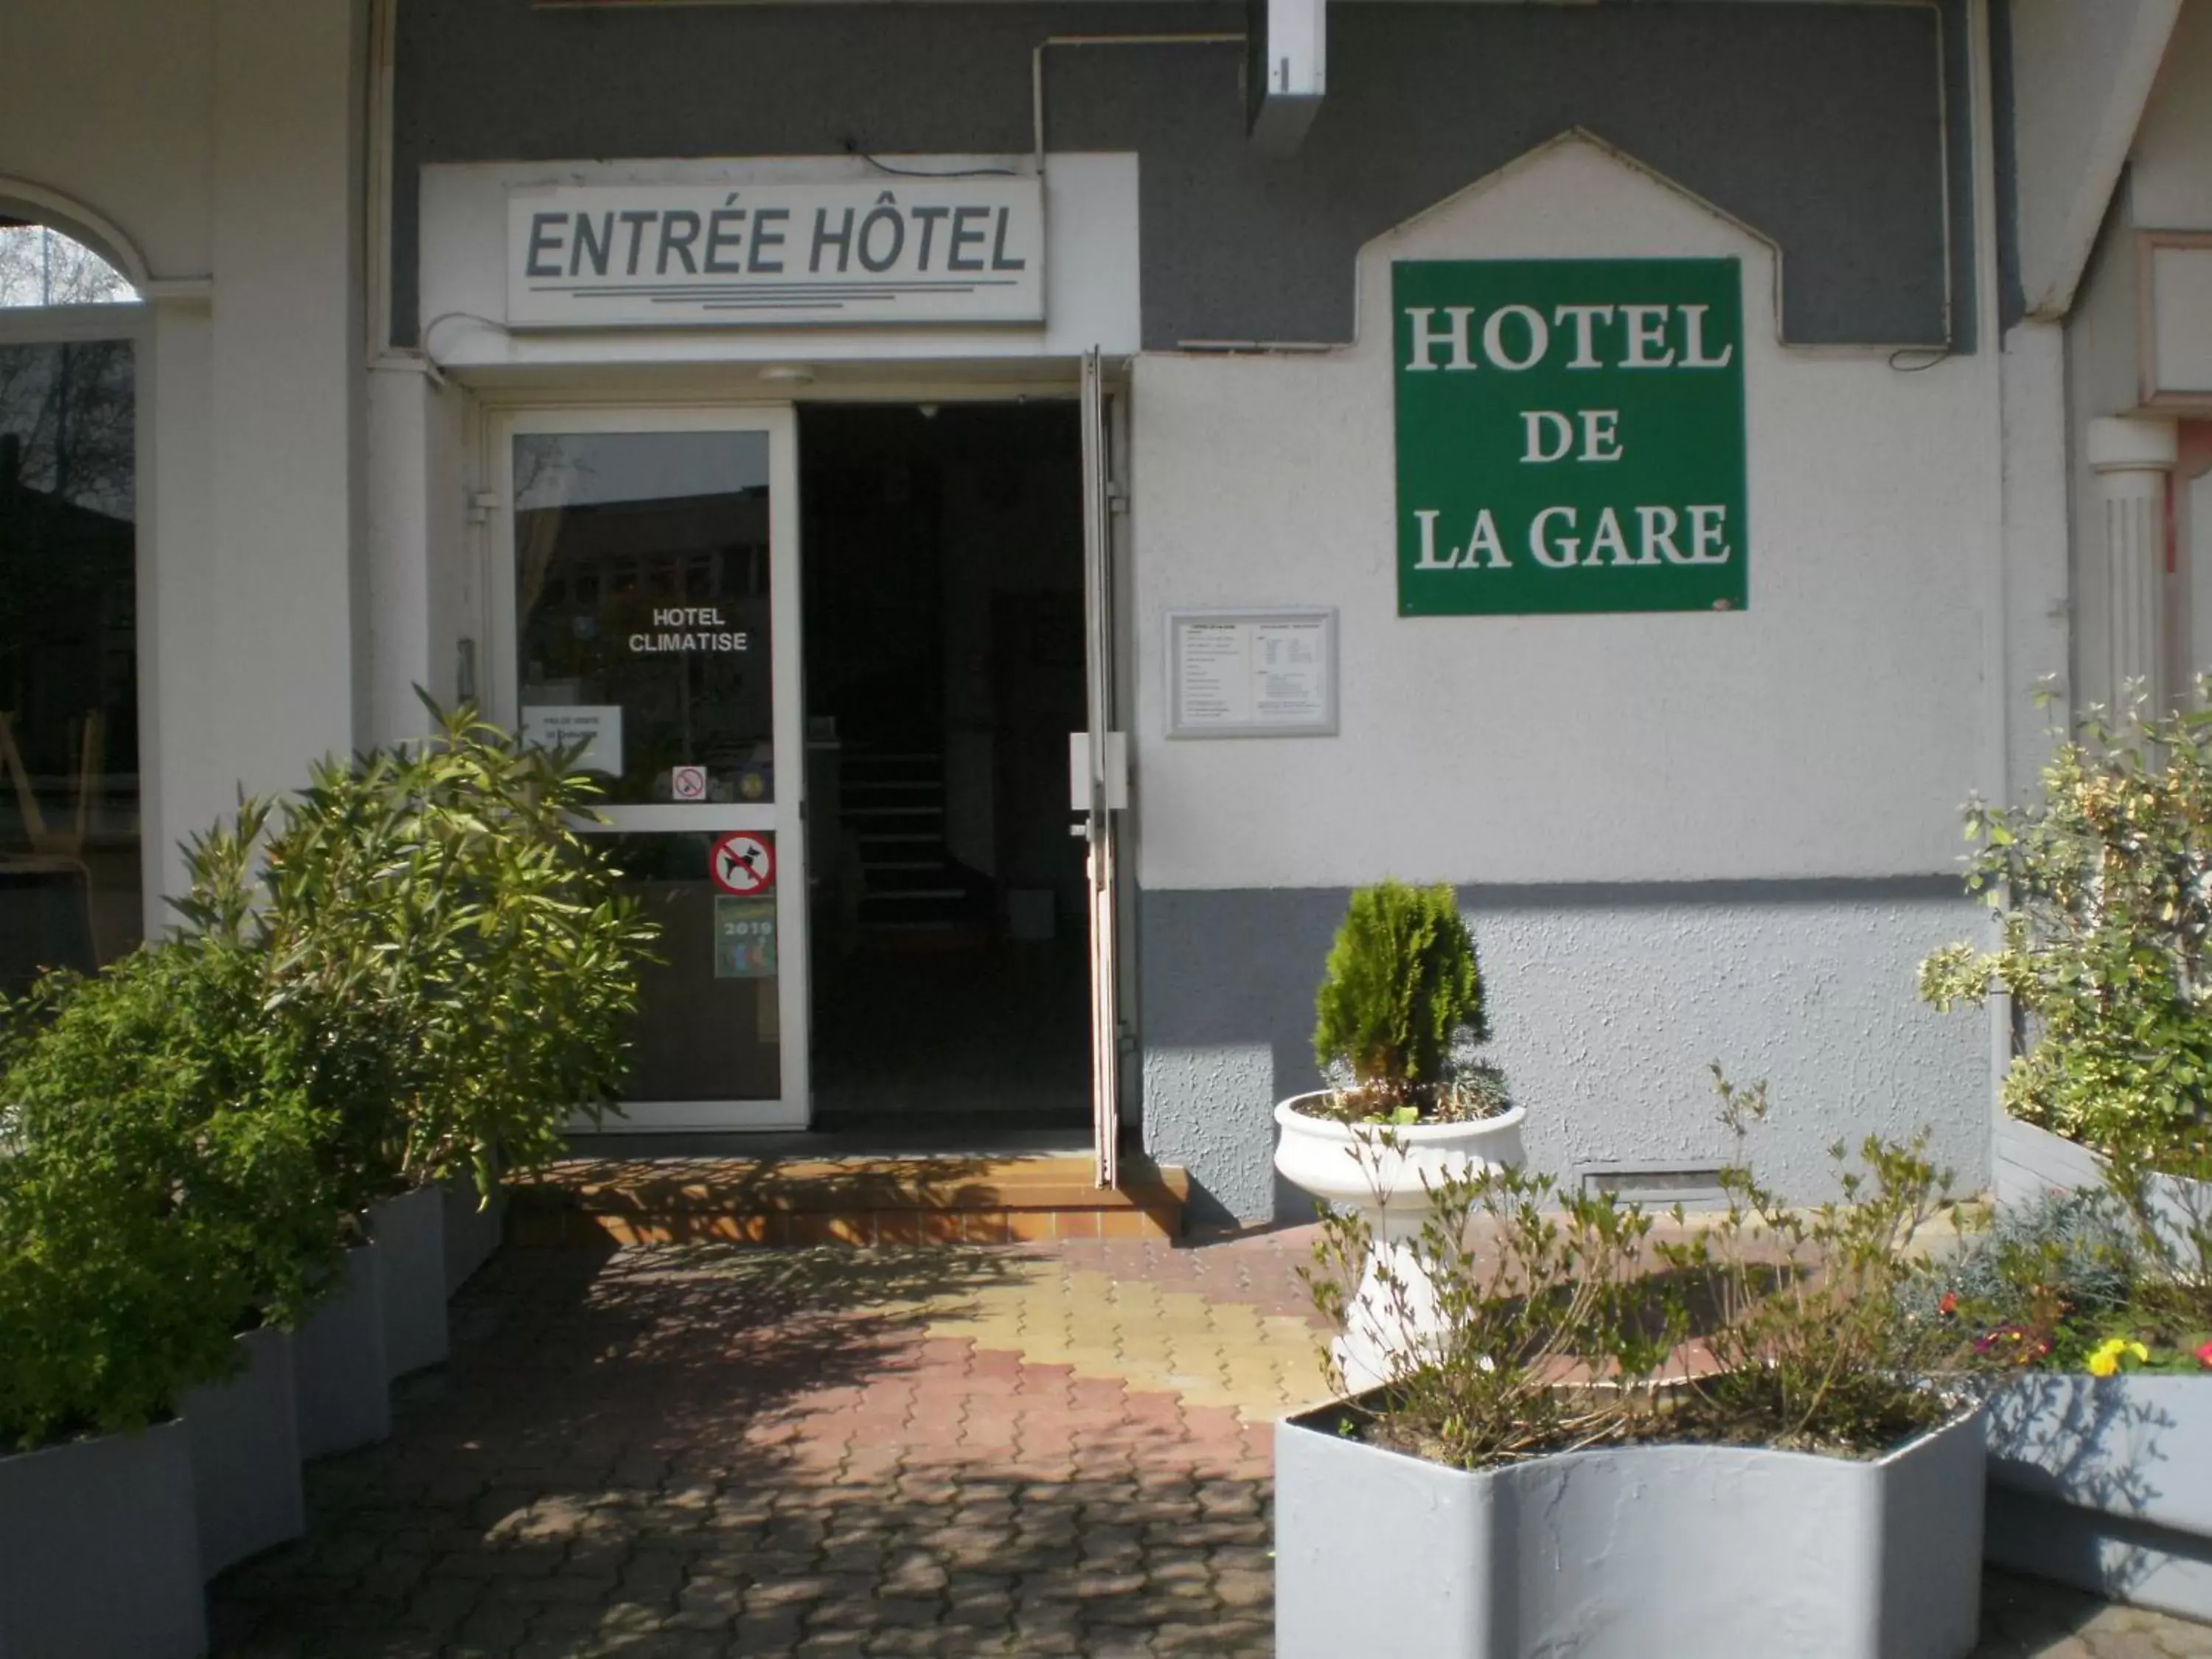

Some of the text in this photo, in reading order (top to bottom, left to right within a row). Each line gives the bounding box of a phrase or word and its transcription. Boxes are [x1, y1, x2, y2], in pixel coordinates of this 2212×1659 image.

[524, 190, 1026, 277] ENTRÉE HÔTEL
[1404, 304, 1733, 371] HOTEL
[1519, 410, 1623, 463] DE
[1413, 505, 1731, 569] LA GARE
[628, 633, 748, 653] CLIMATISE
[653, 608, 726, 627] HOTEL
